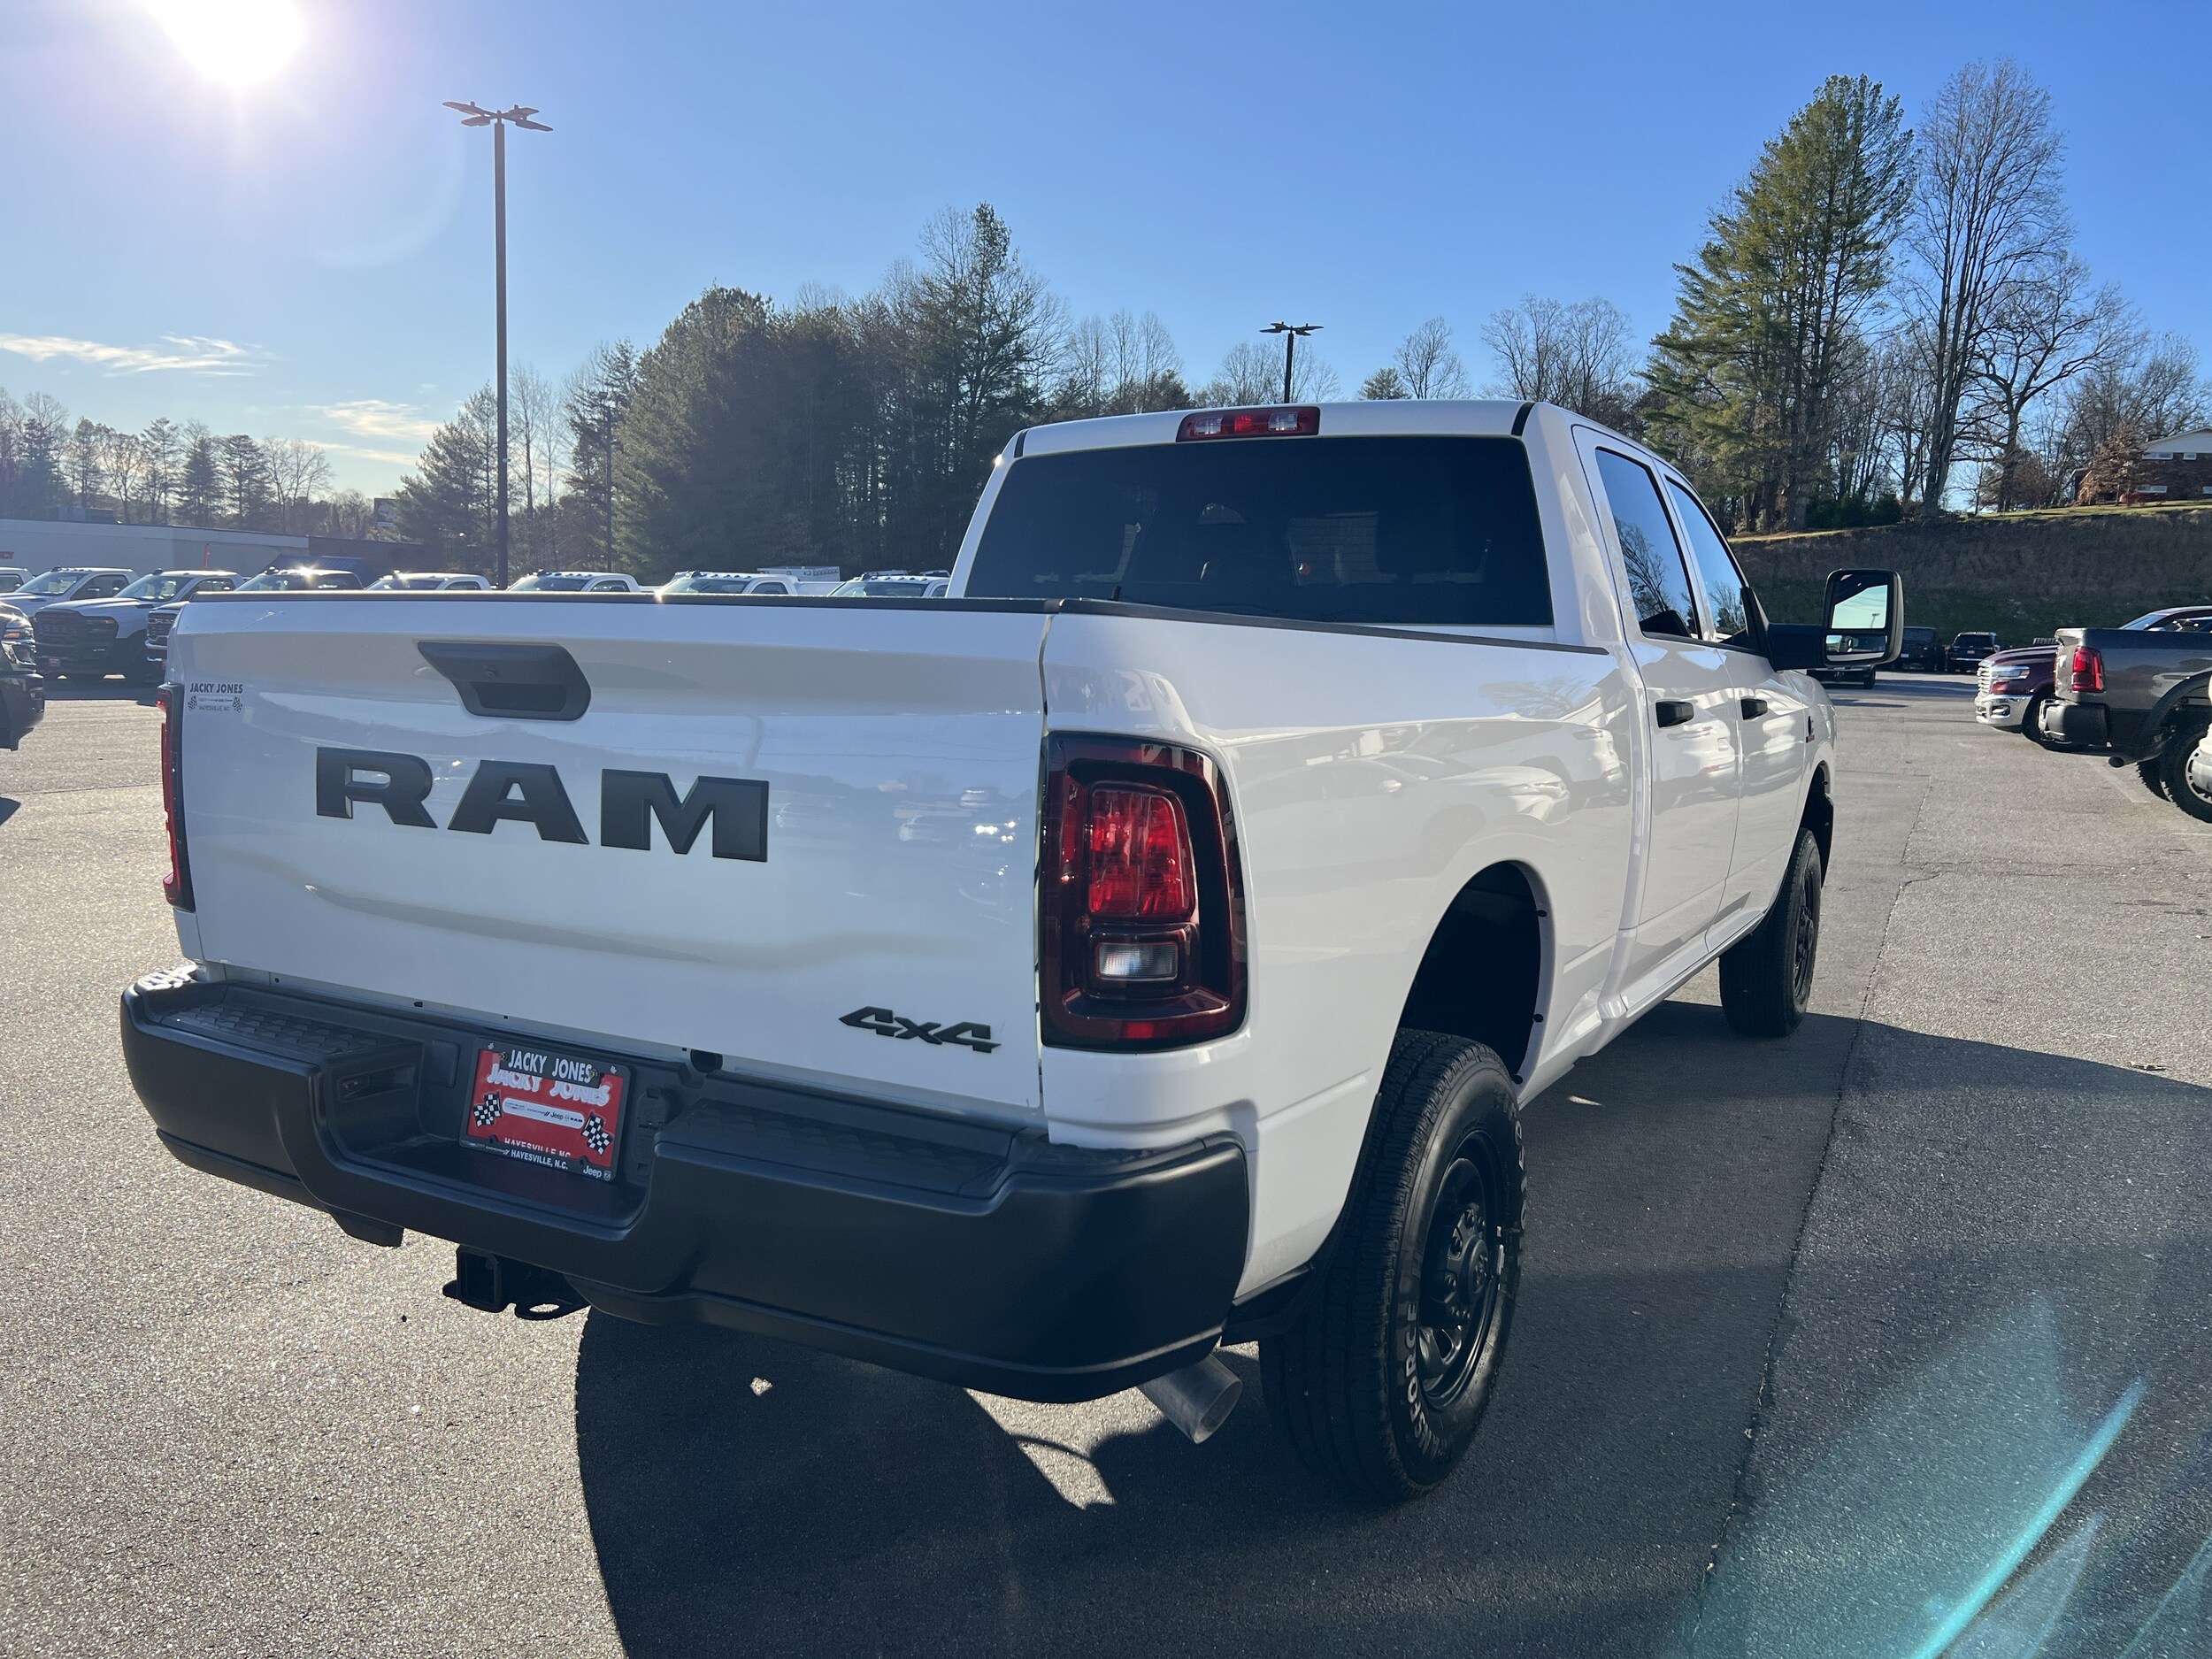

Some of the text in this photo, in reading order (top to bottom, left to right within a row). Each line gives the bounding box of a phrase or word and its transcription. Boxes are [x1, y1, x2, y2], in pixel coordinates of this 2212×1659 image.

[190, 682, 243, 695] JACKY JONES
[317, 747, 769, 862] RAM
[508, 1049, 593, 1083] JACKY JONES
[487, 1064, 611, 1106] JACKY JONES
[550, 1111, 564, 1120] Jeep
[511, 1149, 553, 1167] HAYESVILLE,
[583, 1164, 602, 1179] Jeep
